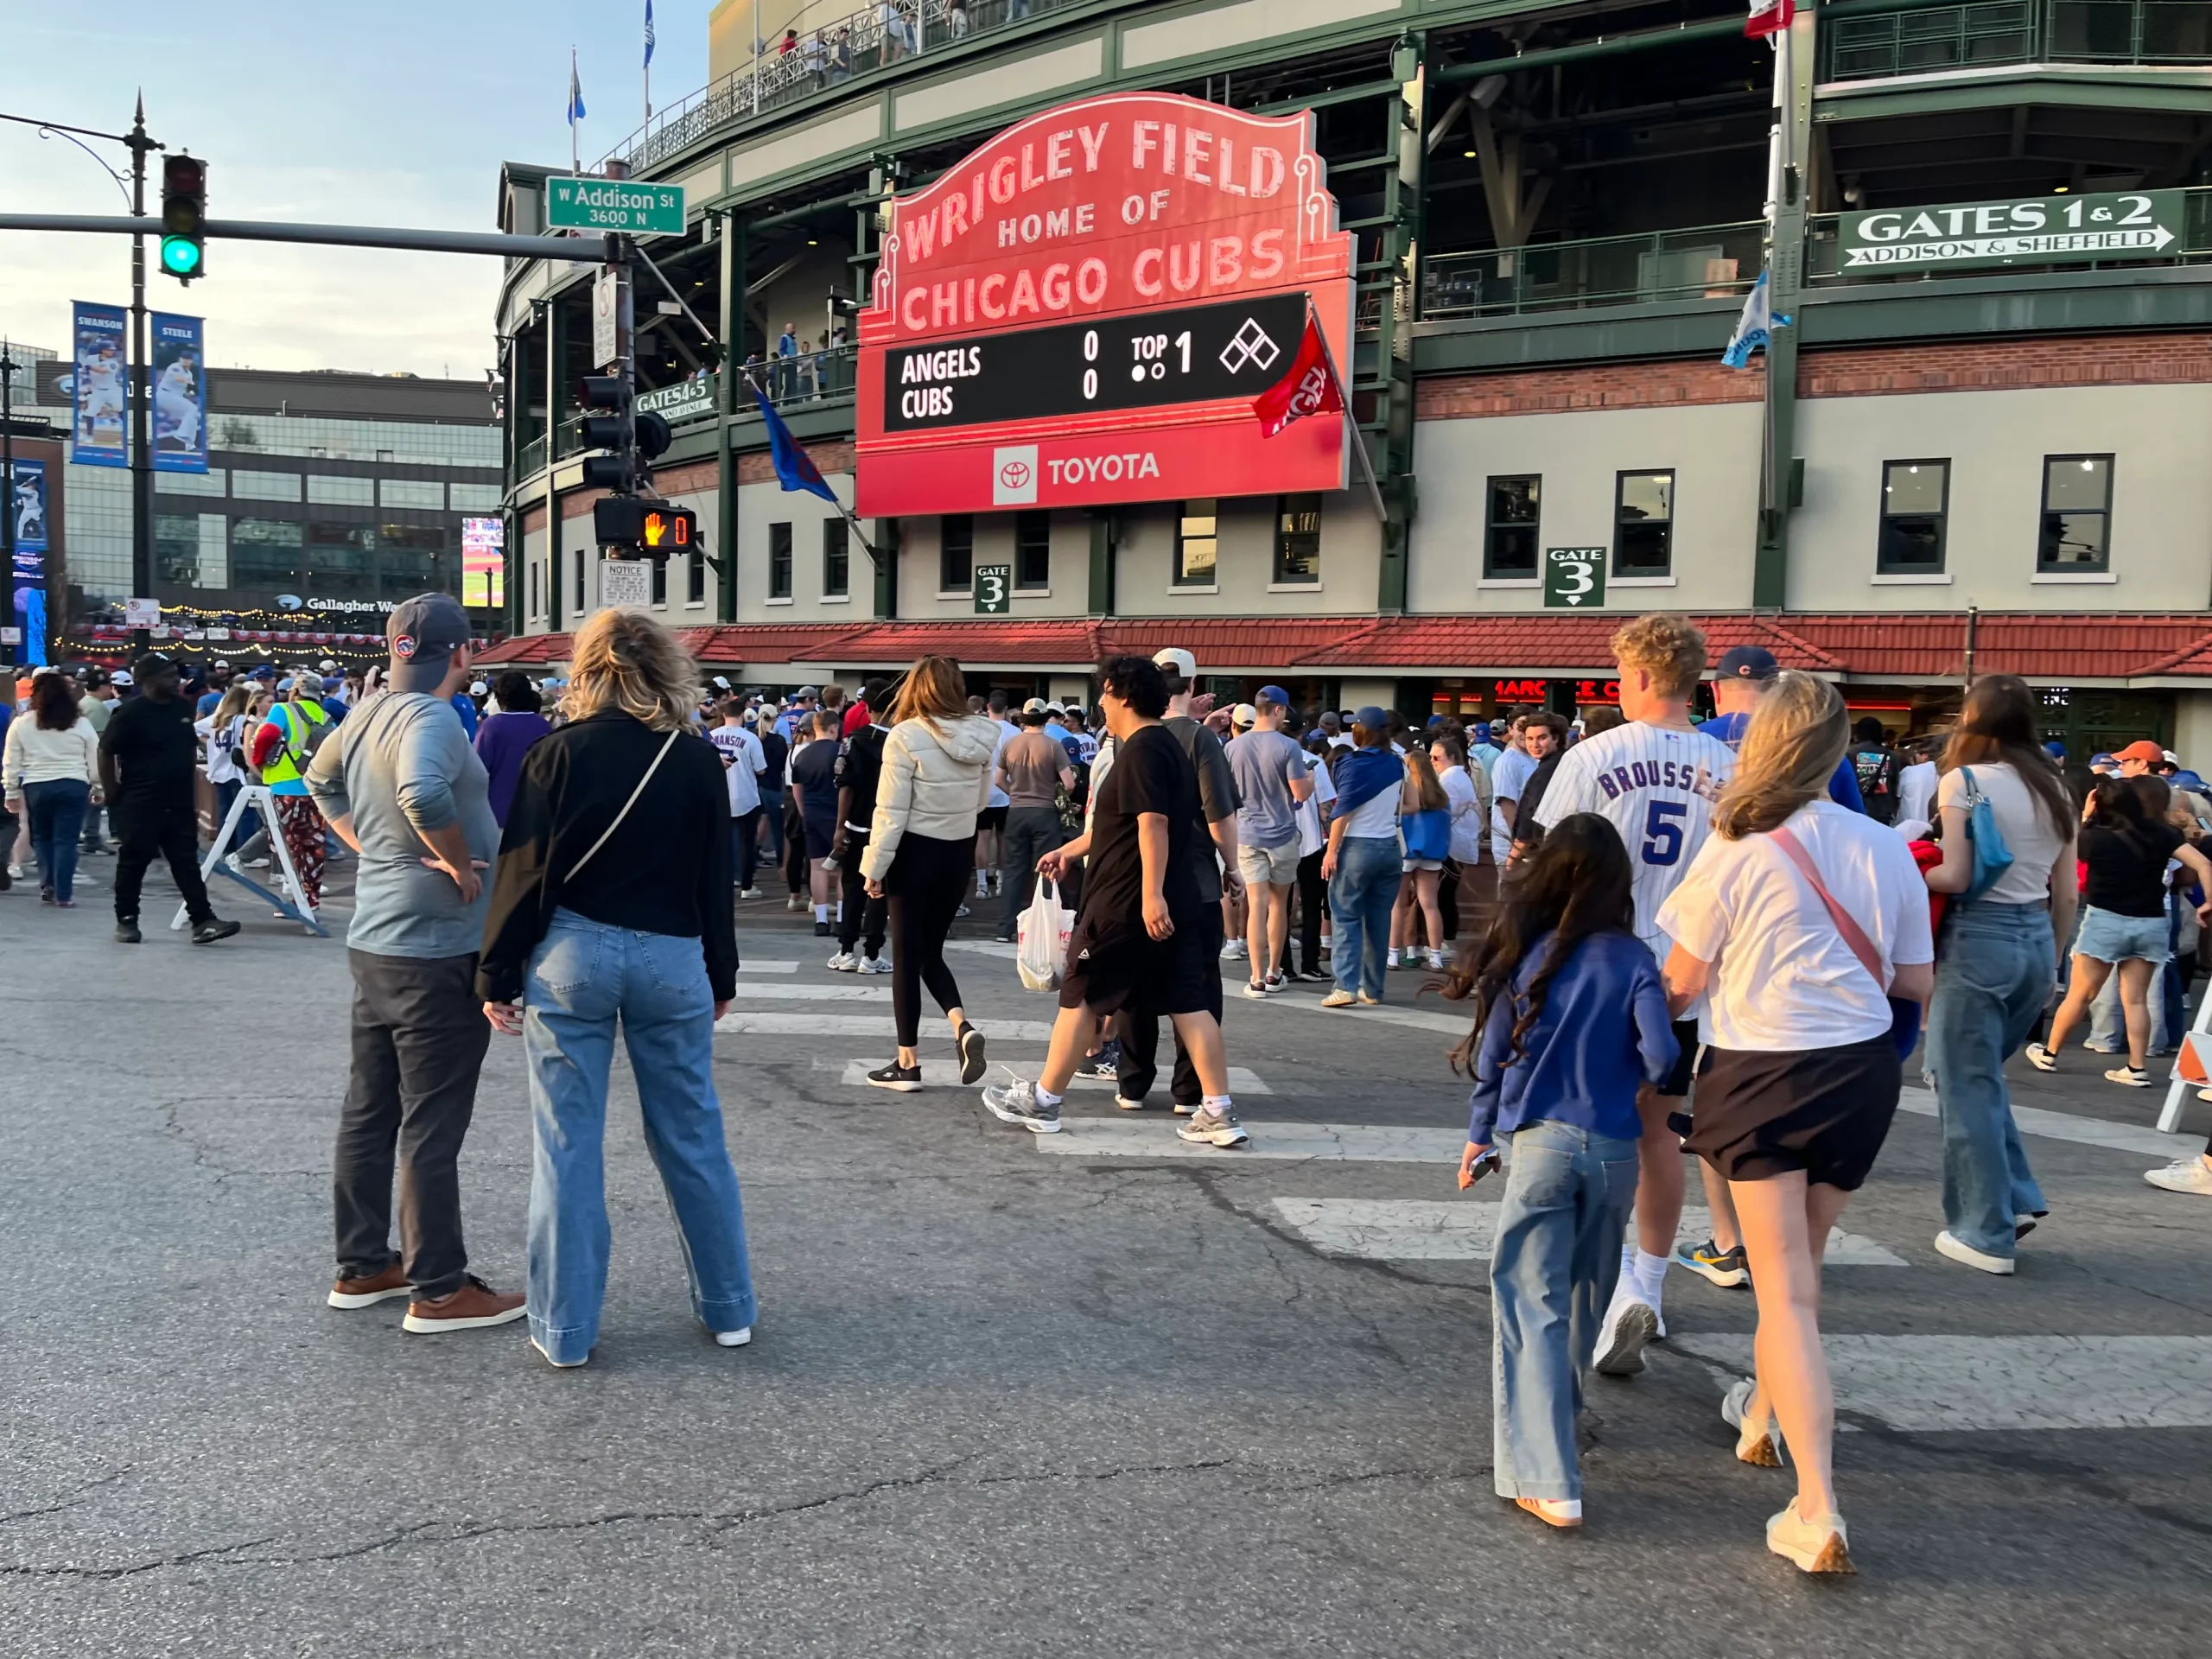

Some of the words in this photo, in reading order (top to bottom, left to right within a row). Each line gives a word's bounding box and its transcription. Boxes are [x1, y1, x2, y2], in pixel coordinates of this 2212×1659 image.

[559, 188, 570, 201] W
[575, 187, 654, 210] Addison
[659, 194, 674, 208] St
[903, 122, 1109, 264] WRIGLEY
[1133, 119, 1285, 199] FIELD
[589, 209, 627, 225] 3600
[637, 213, 646, 226] N
[997, 203, 1095, 248] HOME
[1121, 188, 1170, 226] OF
[1858, 203, 2045, 242] GATES
[1855, 243, 1977, 264] ADDISON
[1986, 240, 2005, 254] &
[2017, 231, 2157, 253] SHEFFIELD
[901, 256, 1108, 332] CHICAGO
[1132, 228, 1284, 297] CUBS
[78, 316, 123, 330] SWANSON
[162, 327, 193, 338] STEELE
[1084, 330, 1099, 361] 0
[1131, 334, 1168, 361] TOP
[1174, 330, 1192, 373] 1
[900, 346, 981, 385] ANGELS
[637, 387, 682, 412] GATES
[1083, 368, 1098, 400] 0
[901, 385, 953, 419] CUBS
[1047, 452, 1160, 485] TOYOTA
[609, 565, 642, 575] NOTICE
[977, 566, 1008, 576] GATE
[1549, 549, 1603, 561] GATE
[981, 576, 1003, 603] 3
[1555, 561, 1594, 594] 3
[307, 598, 375, 613] Gallagher
[1642, 799, 1688, 867] 5
